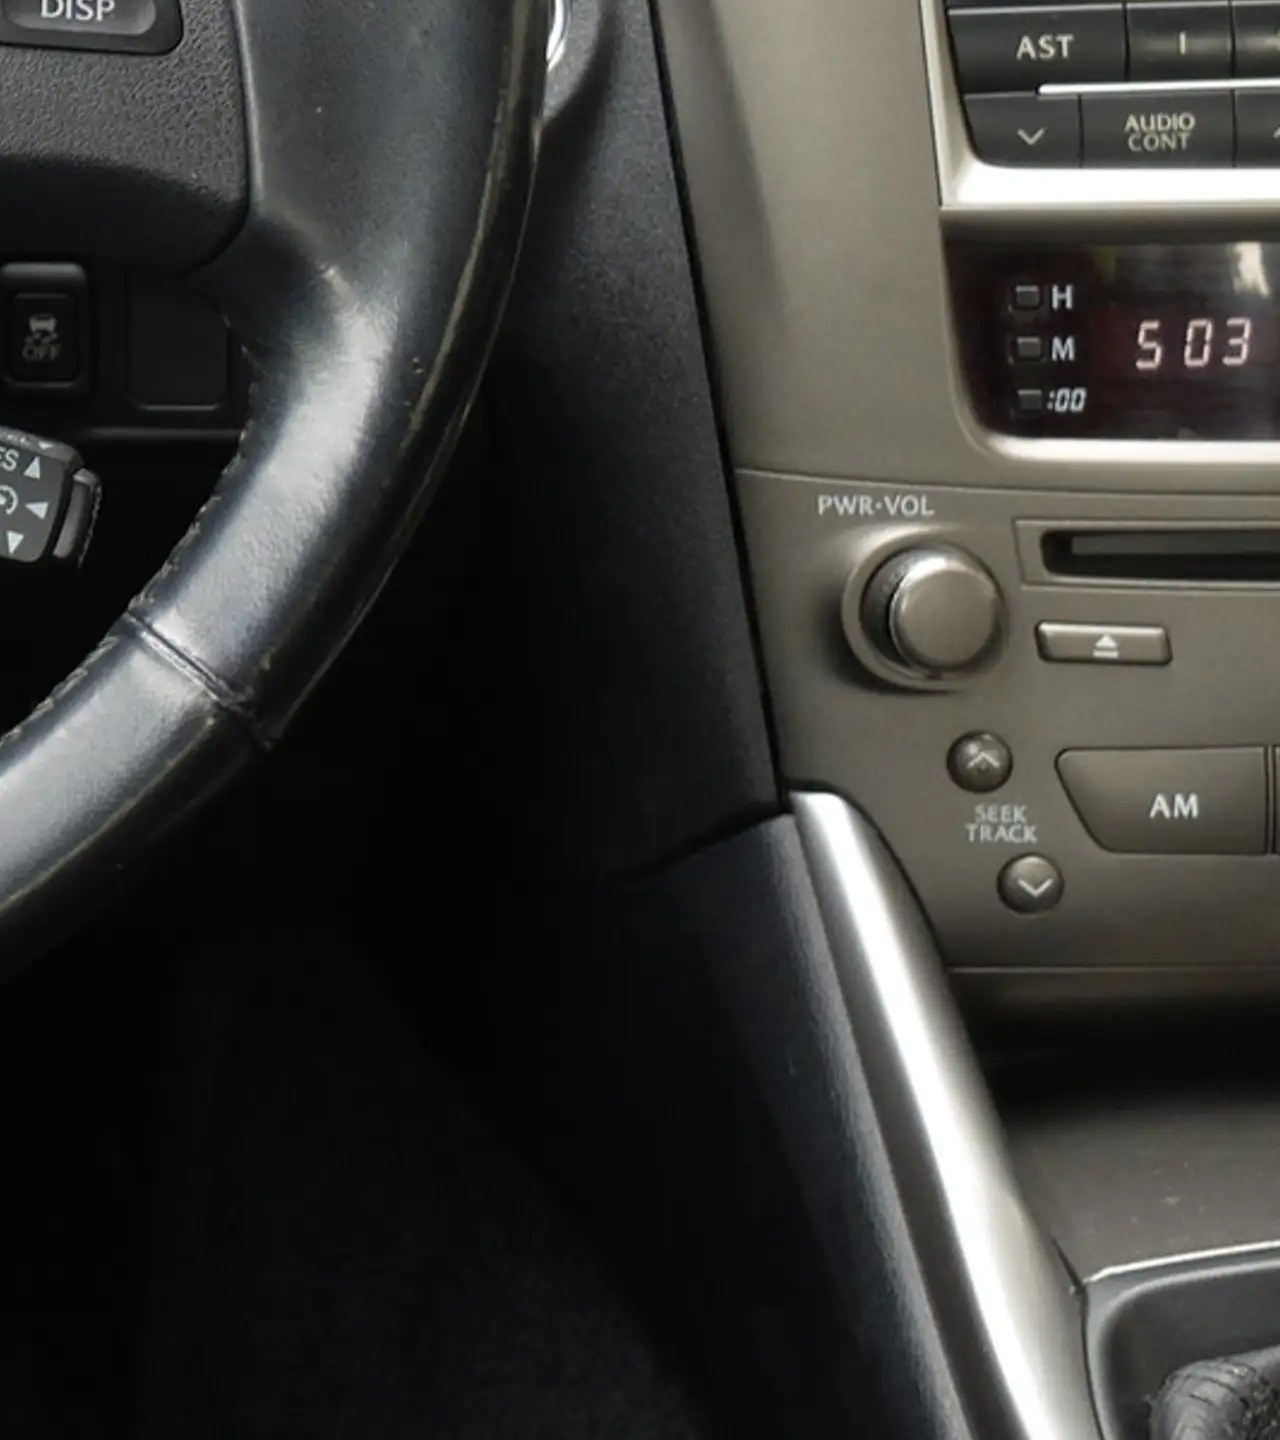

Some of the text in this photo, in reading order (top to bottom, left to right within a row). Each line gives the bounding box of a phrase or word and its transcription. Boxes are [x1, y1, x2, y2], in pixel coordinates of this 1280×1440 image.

[1017, 35, 1074, 60] AST
[1124, 113, 1196, 133] AUDIO
[1128, 132, 1189, 152] CONT
[1051, 285, 1074, 310] H
[1051, 337, 1075, 361] M
[974, 805, 1027, 823] SEEK
[1150, 794, 1200, 819] AM
[965, 824, 1038, 844] TRACK
